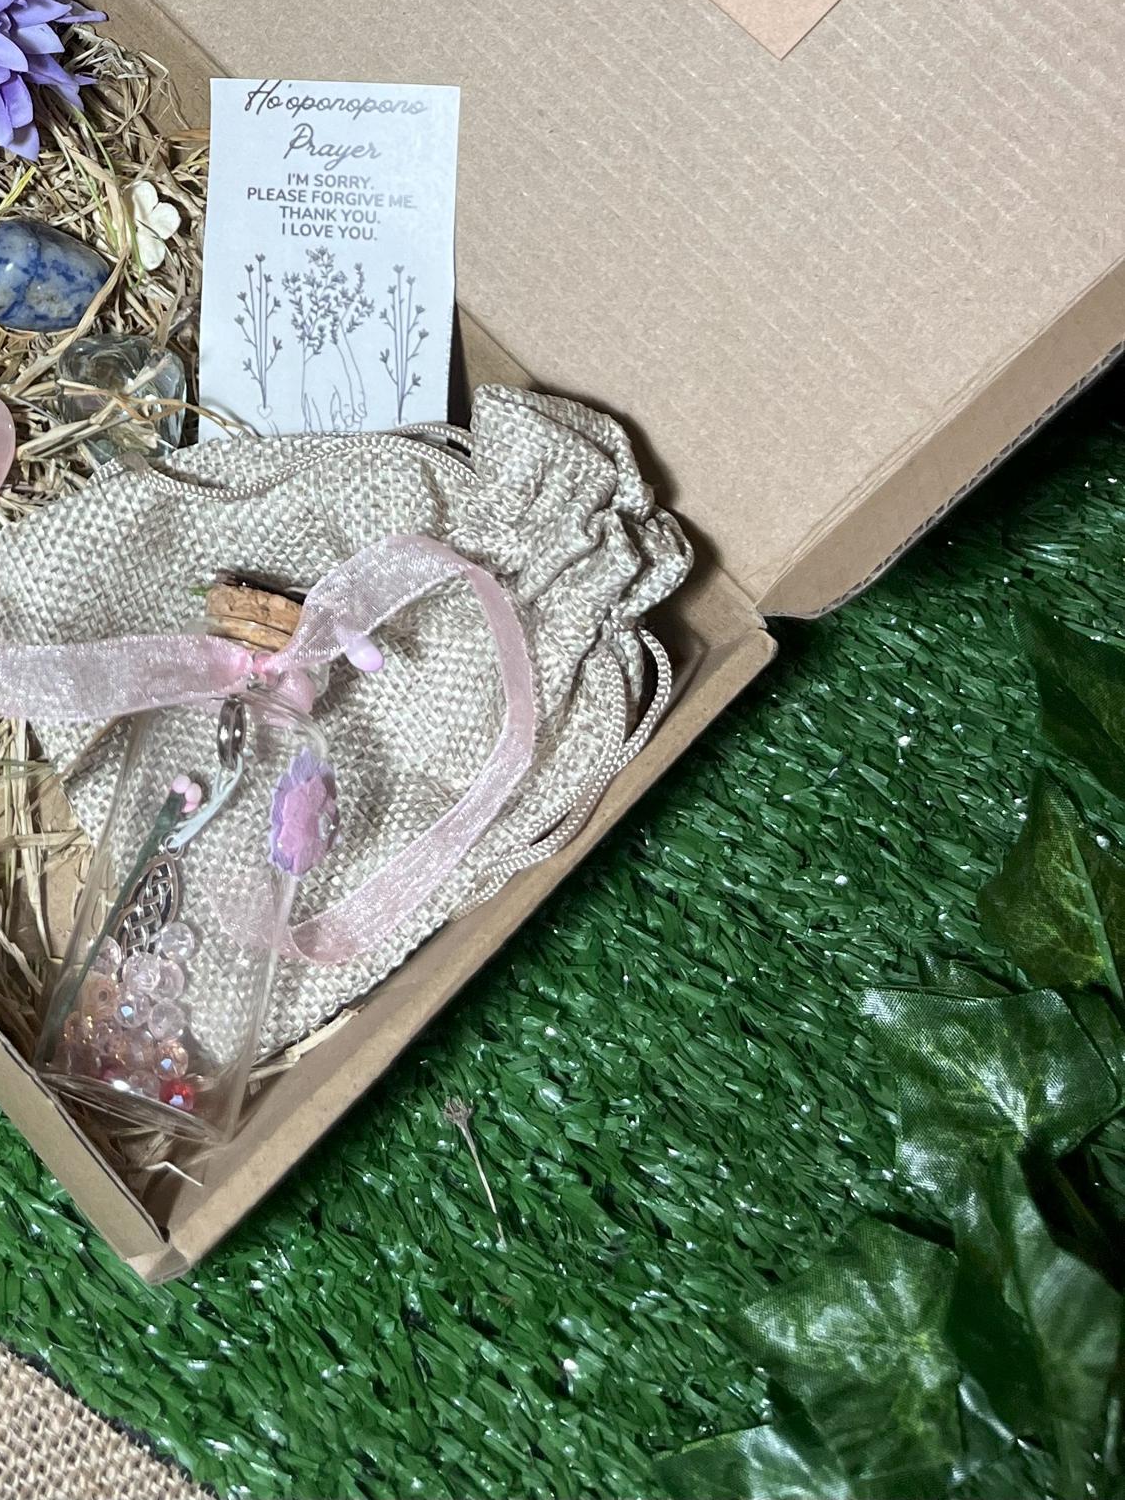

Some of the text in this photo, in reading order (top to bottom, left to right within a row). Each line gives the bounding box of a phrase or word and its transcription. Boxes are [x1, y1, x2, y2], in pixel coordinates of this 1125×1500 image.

[283, 123, 381, 171] Prayer
[287, 173, 374, 190] I'M SORRY.
[247, 187, 307, 203] PLEASE
[311, 190, 384, 207] FORGIVE
[279, 205, 381, 224] THANK YOU.
[291, 223, 334, 238] LOVE
[338, 227, 378, 241] YOU.
